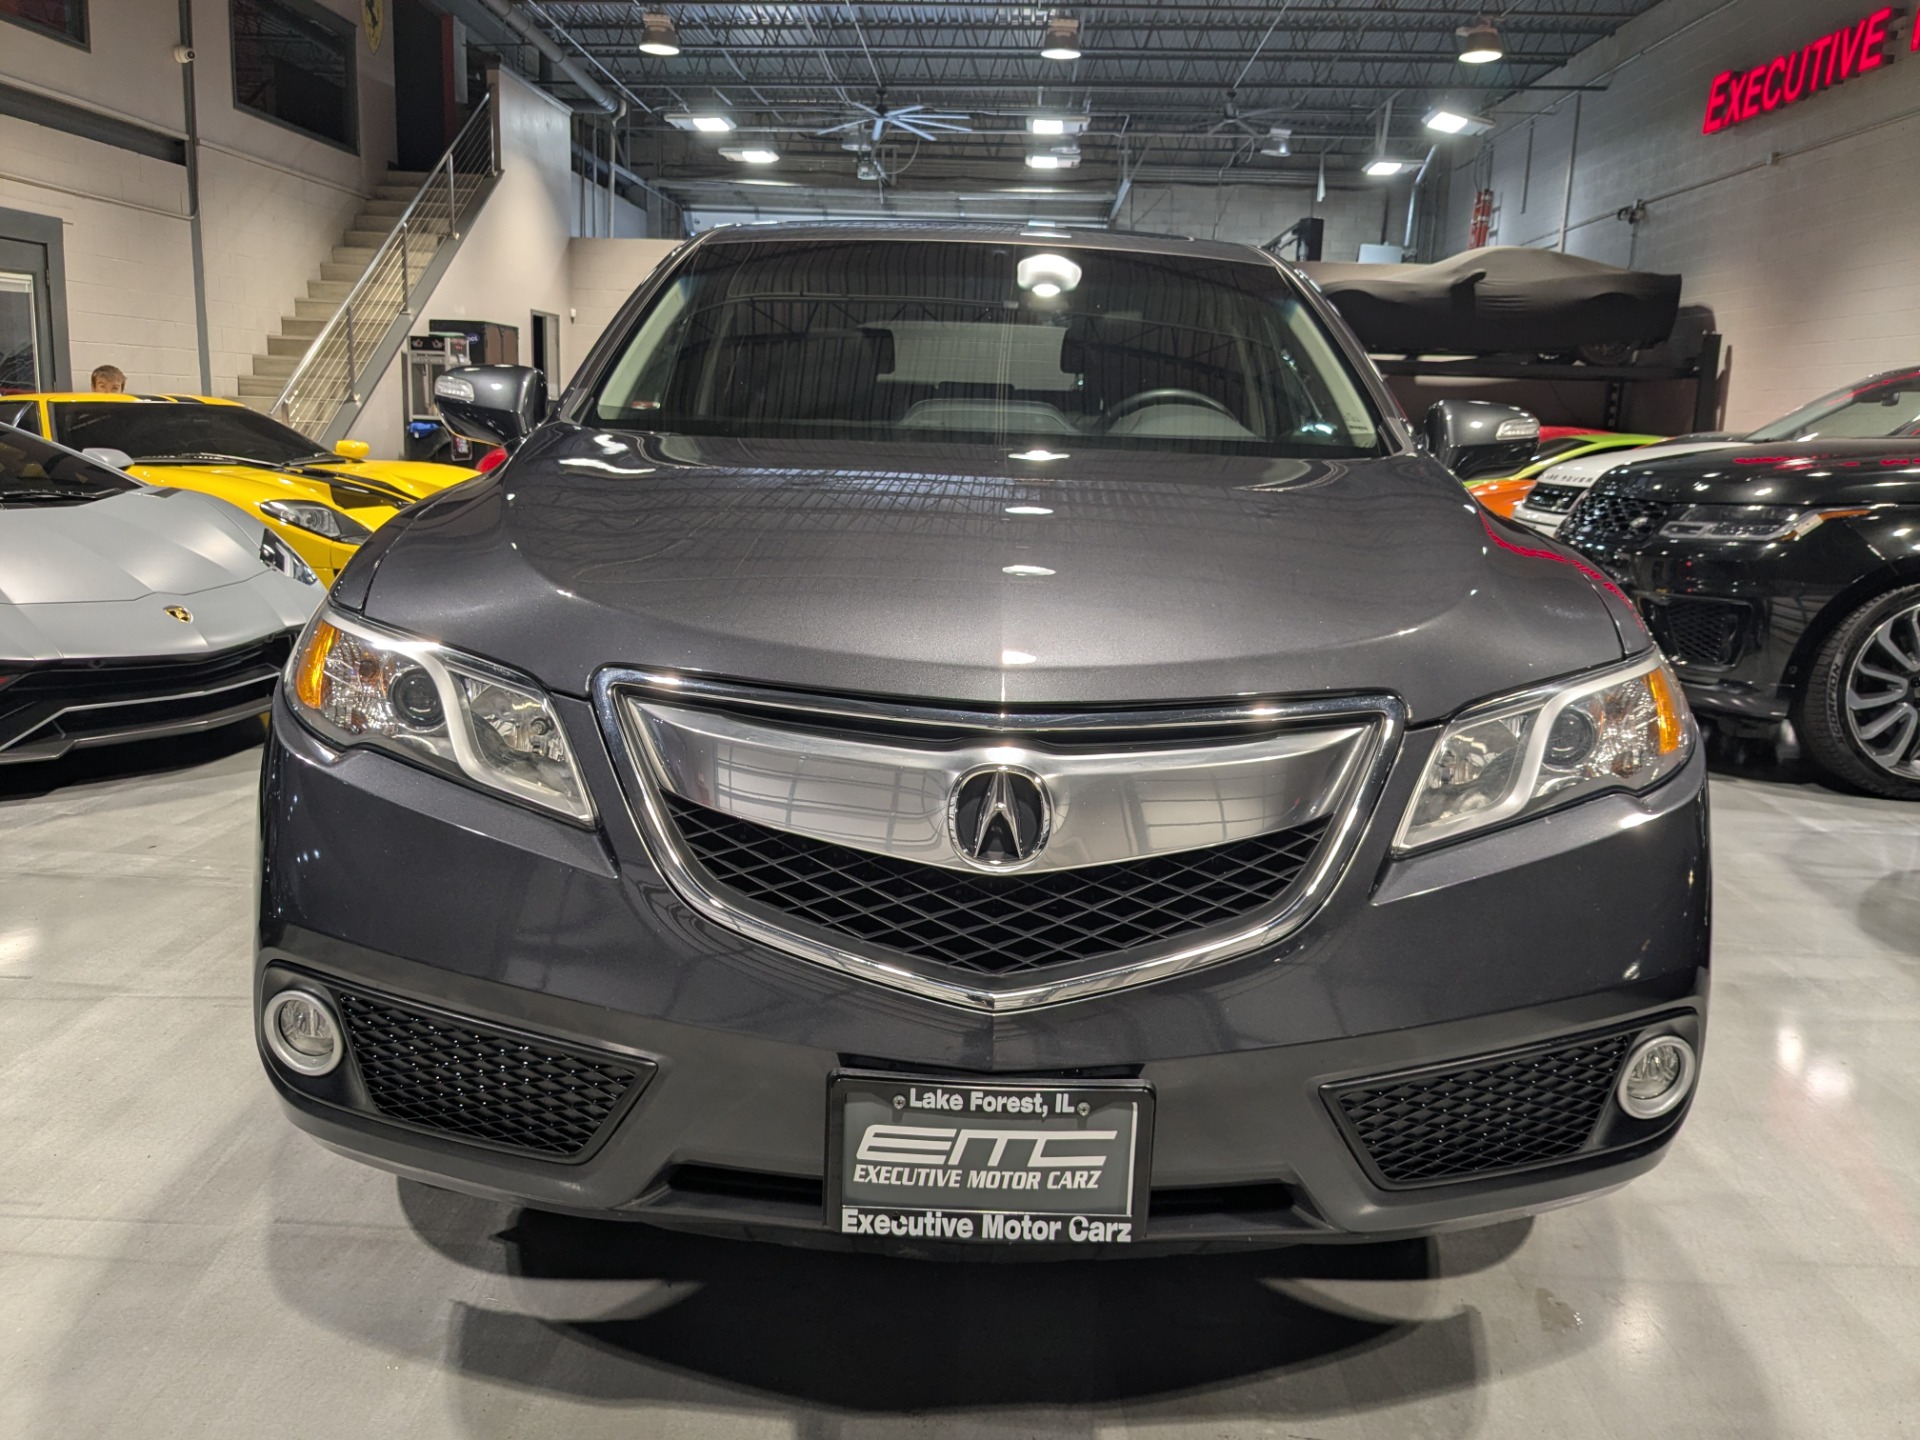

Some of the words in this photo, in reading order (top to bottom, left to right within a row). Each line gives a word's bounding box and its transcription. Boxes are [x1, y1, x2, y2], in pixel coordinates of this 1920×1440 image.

[1702, 7, 1892, 135] EXECUTIVE
[909, 1087, 964, 1111] Lake
[970, 1091, 1048, 1118] Forest,
[1055, 1093, 1075, 1113] IL
[853, 1164, 963, 1188] EXECUTIVE
[967, 1170, 1042, 1190] MOTOR
[1047, 1170, 1102, 1190] CARZ
[842, 1208, 974, 1239] Executive
[981, 1214, 1062, 1240] Motor
[1068, 1215, 1132, 1243] Carz
